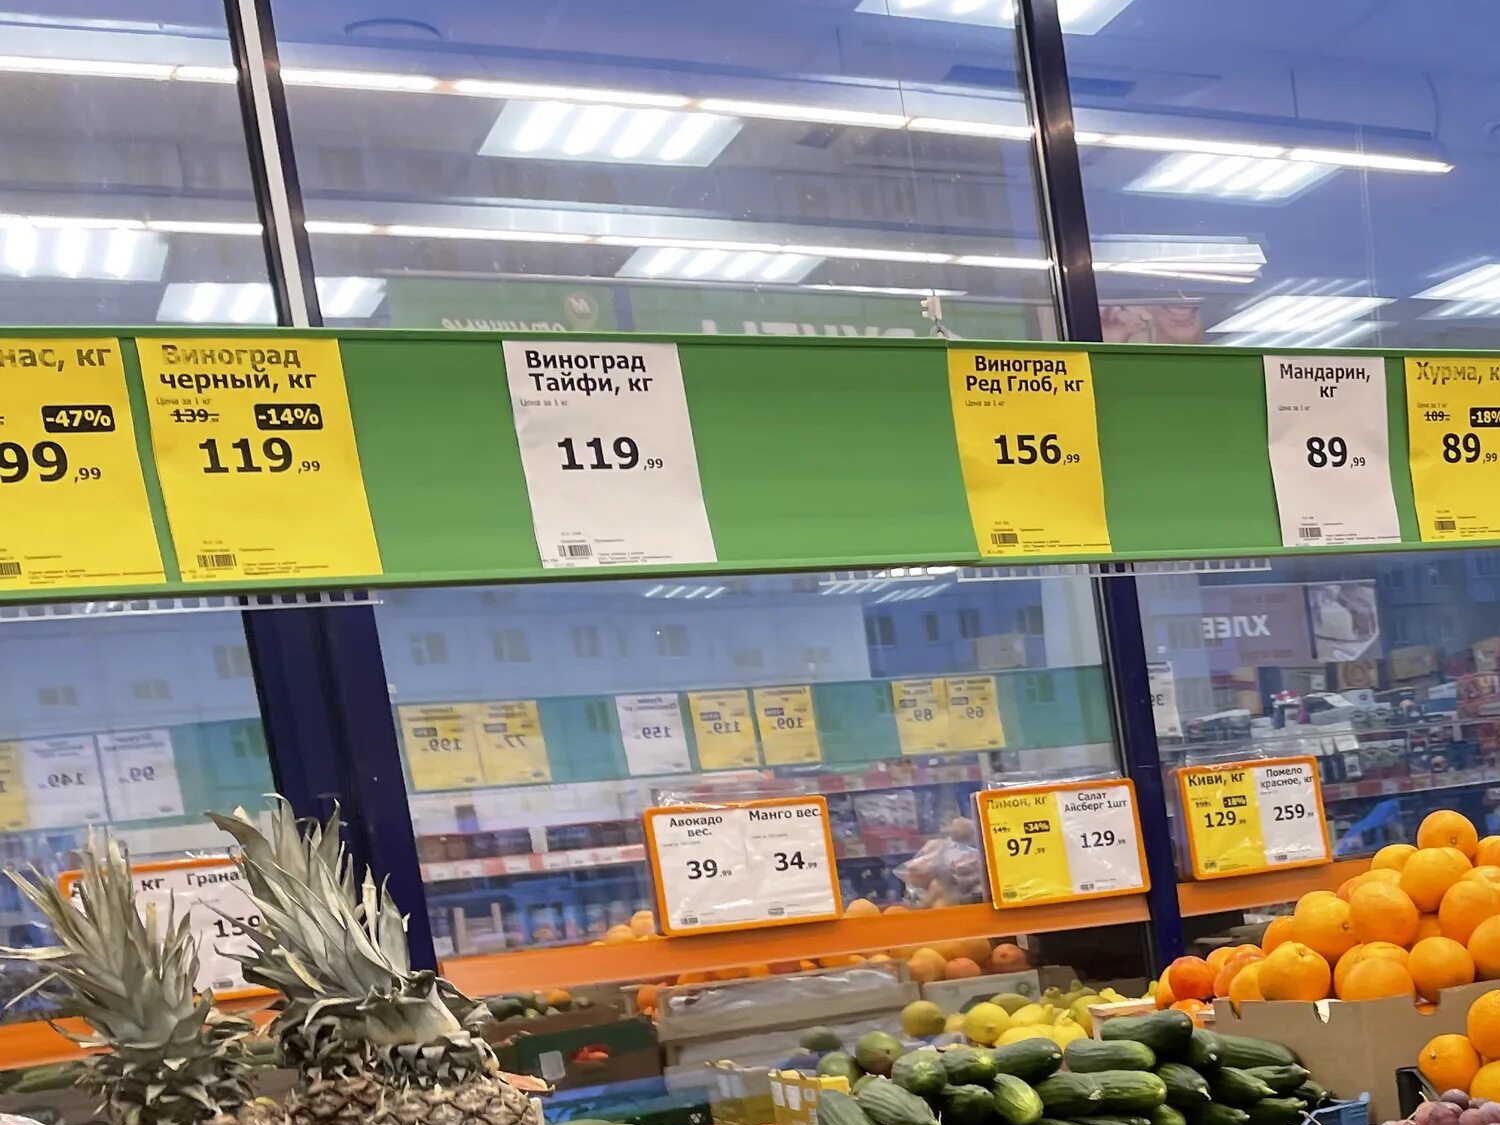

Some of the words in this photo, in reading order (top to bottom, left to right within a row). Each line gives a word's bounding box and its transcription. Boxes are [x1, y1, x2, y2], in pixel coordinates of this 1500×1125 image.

[76, 348, 112, 367] кг
[162, 345, 301, 371] Виноград
[525, 350, 646, 373] Виноград
[975, 355, 1067, 376] Виноград
[160, 369, 279, 394] черный,
[288, 373, 317, 389] кг
[1280, 363, 1371, 382] Мандарин,
[1416, 362, 1482, 385] Хурма,
[528, 372, 621, 396] Тайфи,
[629, 377, 653, 392] кг
[965, 375, 1002, 394] Ред
[1007, 376, 1058, 395] Глоб,
[1065, 379, 1084, 392] кг
[1320, 386, 1338, 398] кг
[45, 408, 112, 428] -47%
[257, 408, 319, 426] -14%
[1188, 774, 1227, 787] Киви,
[1231, 772, 1245, 783] кг
[1266, 767, 1303, 778] Помело
[1035, 796, 1048, 806] кг
[1078, 792, 1107, 801] Салат
[749, 809, 792, 822] Манго
[1064, 801, 1103, 812] Айсберг
[669, 815, 723, 828] Авокадо
[687, 829, 712, 837] вес.
[141, 878, 165, 891] кг
